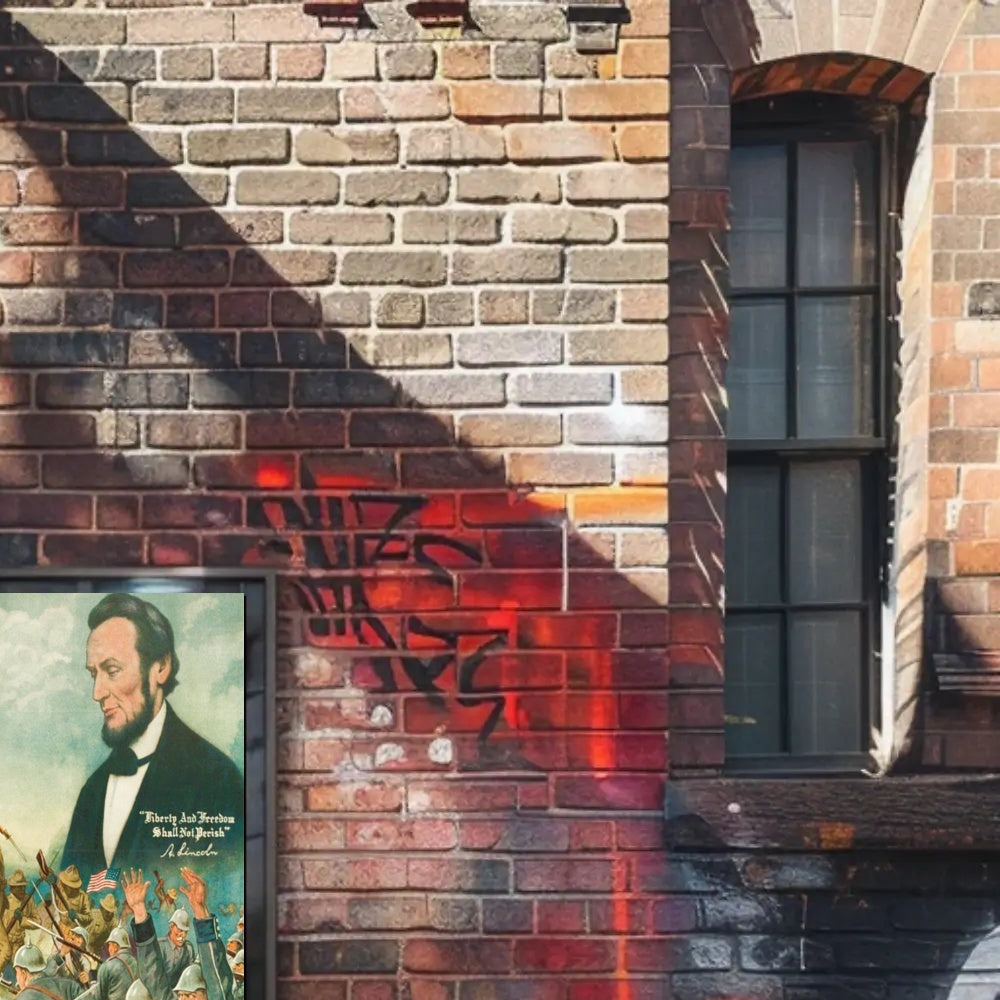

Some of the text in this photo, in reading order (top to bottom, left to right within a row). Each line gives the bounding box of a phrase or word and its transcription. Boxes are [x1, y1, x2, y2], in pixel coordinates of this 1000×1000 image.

[179, 812, 197, 824] And
[197, 811, 235, 824] Freedom
[152, 827, 179, 838] Shall
[179, 827, 194, 838] Not
[177, 842, 218, 857] Lincoln
